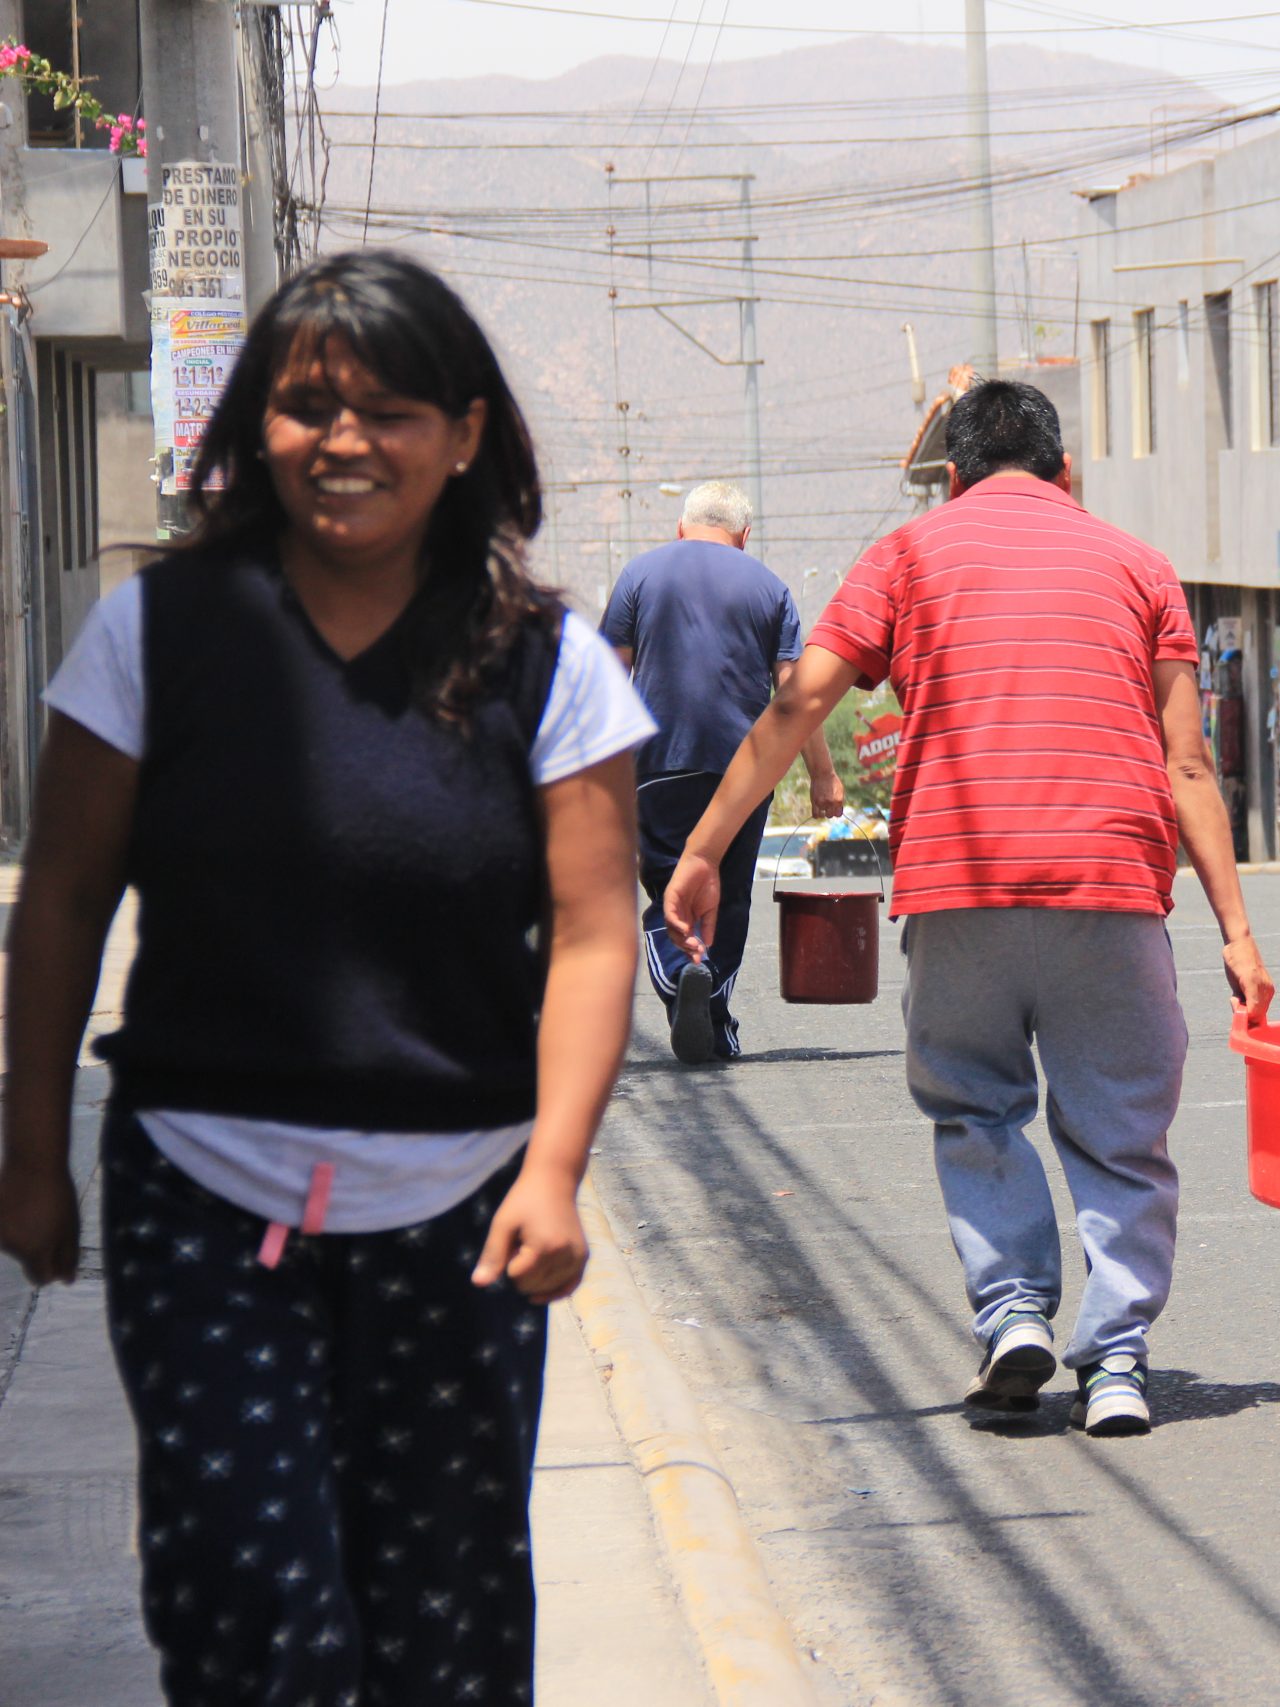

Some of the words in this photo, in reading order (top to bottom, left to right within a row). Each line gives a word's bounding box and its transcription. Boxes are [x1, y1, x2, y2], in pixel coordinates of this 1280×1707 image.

[162, 167, 237, 186] PRESTAMO
[164, 189, 184, 205] DE
[190, 188, 238, 206] DINERO
[184, 209, 203, 226] EN
[208, 209, 226, 226] SU
[175, 229, 237, 247] PROPIO
[168, 250, 240, 267] NEGOCIO
